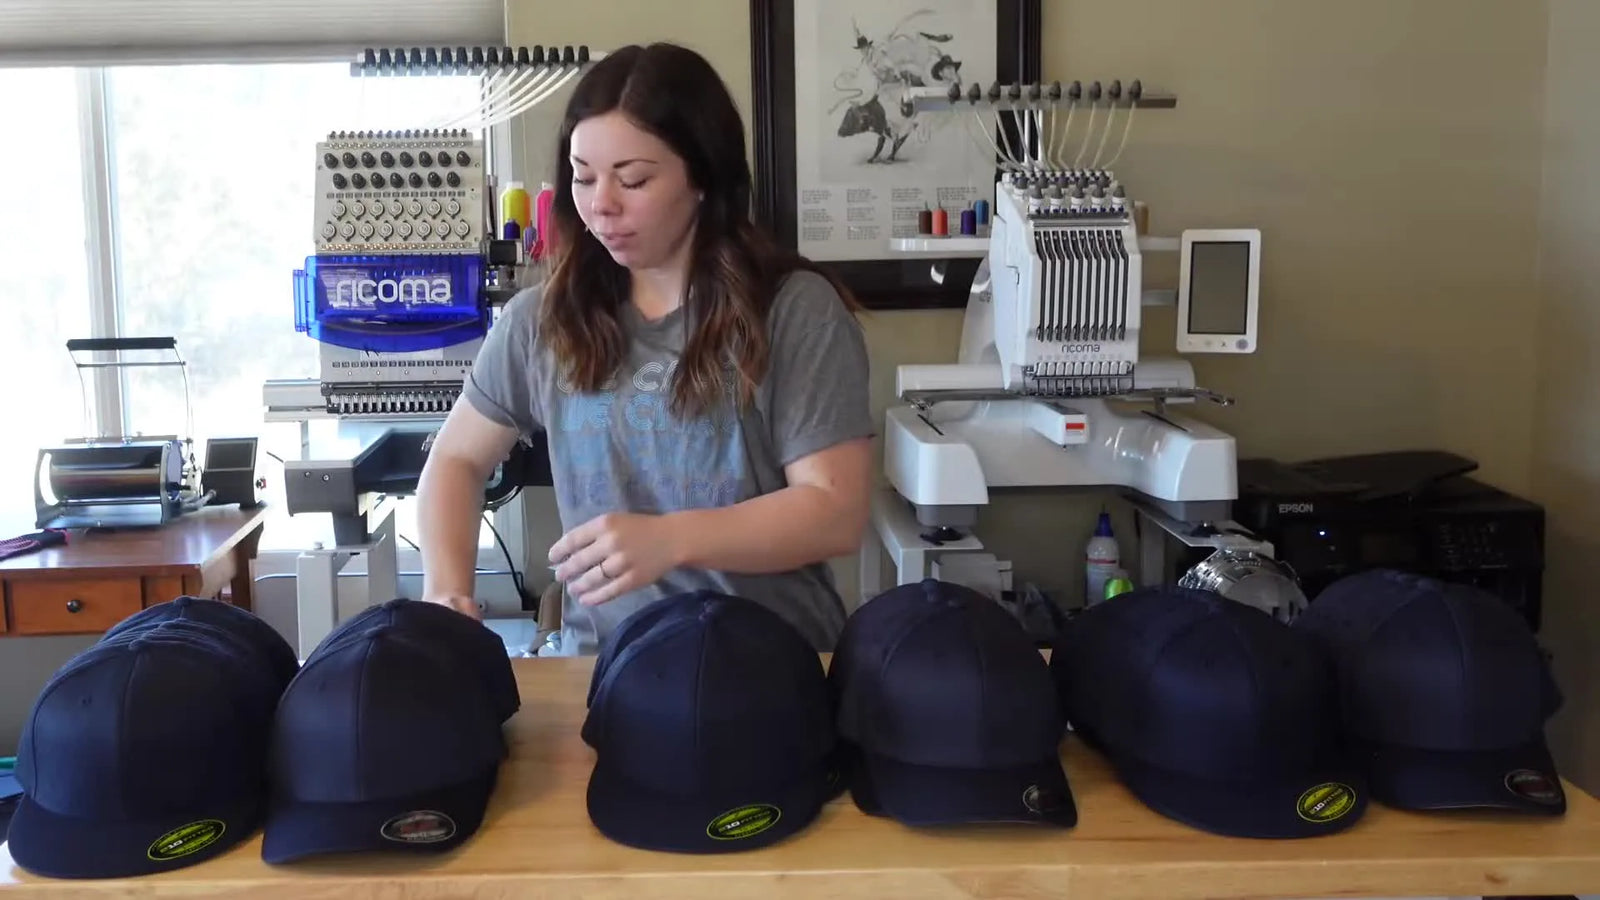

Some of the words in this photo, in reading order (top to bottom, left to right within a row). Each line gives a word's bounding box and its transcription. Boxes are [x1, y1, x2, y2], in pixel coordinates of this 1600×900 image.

[336, 278, 451, 305] ricoma
[1061, 344, 1100, 353] ricoma
[1279, 503, 1313, 513] EPSON
